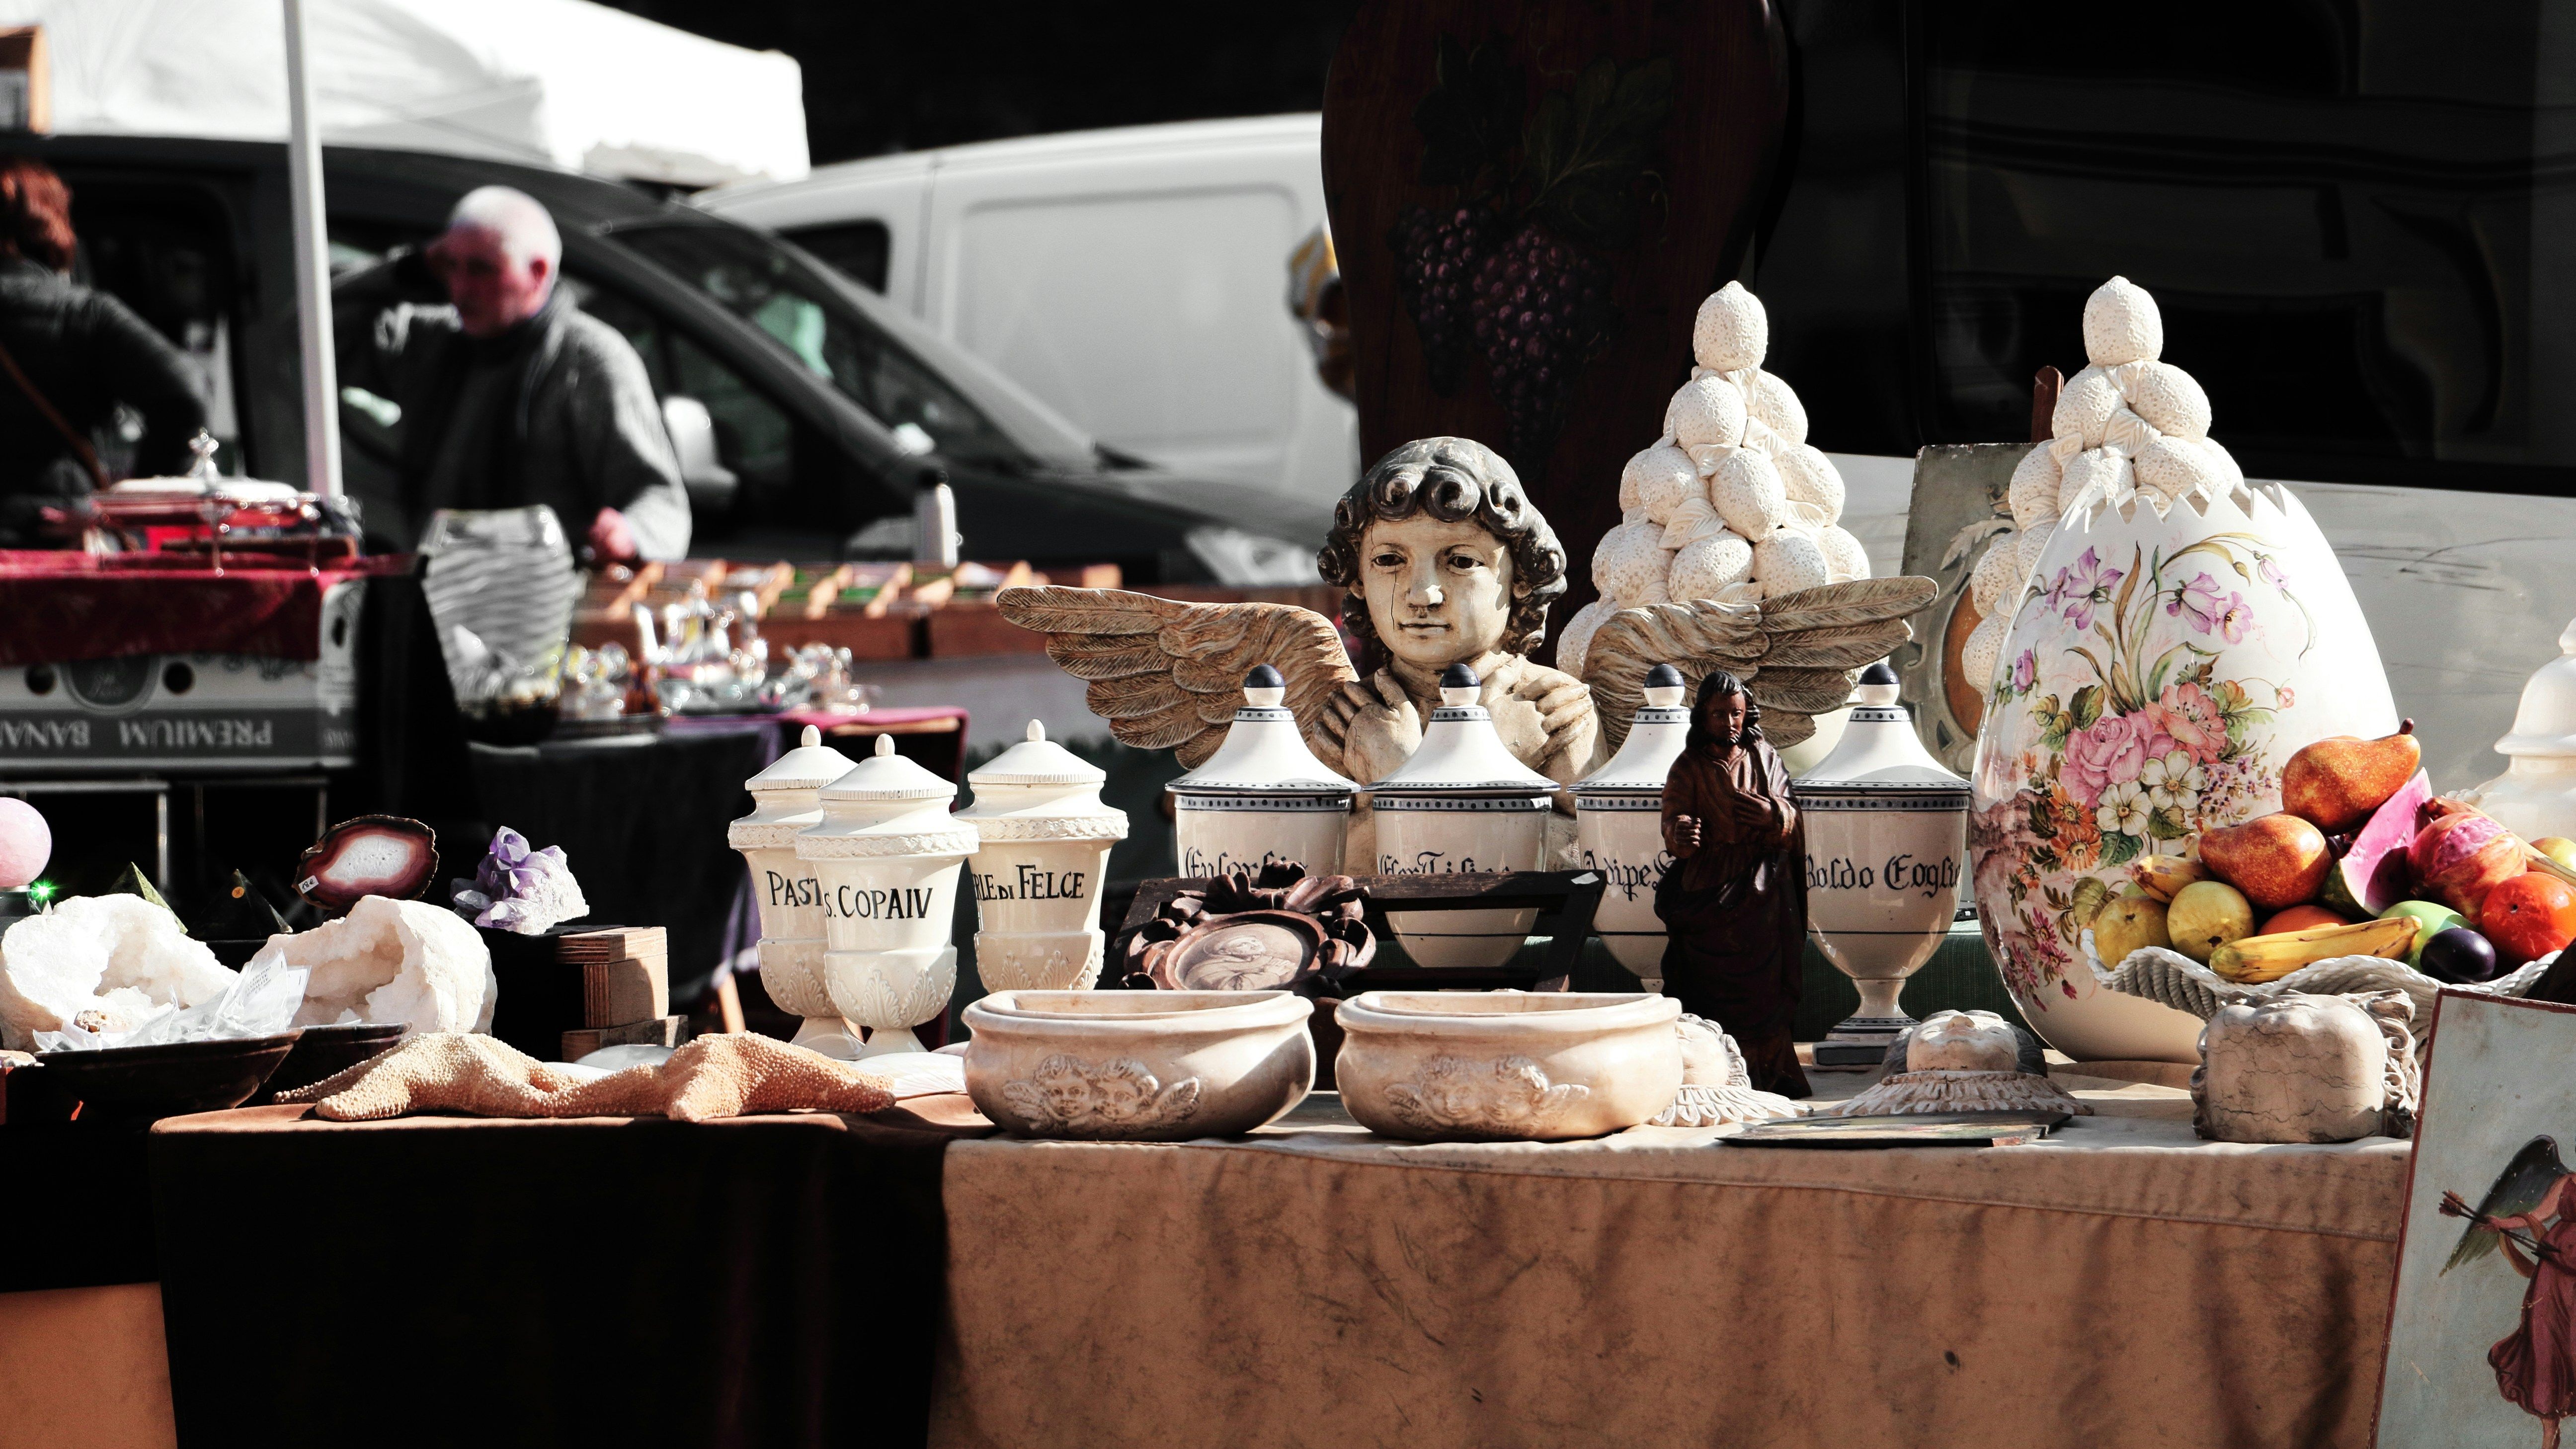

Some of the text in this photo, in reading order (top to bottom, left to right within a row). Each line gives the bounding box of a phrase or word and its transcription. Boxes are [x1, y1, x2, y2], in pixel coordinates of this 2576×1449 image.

[0, 720, 272, 747] PREMIUM BANA
[1015, 864, 1085, 899] FELCE
[838, 885, 933, 919] COPAIV
